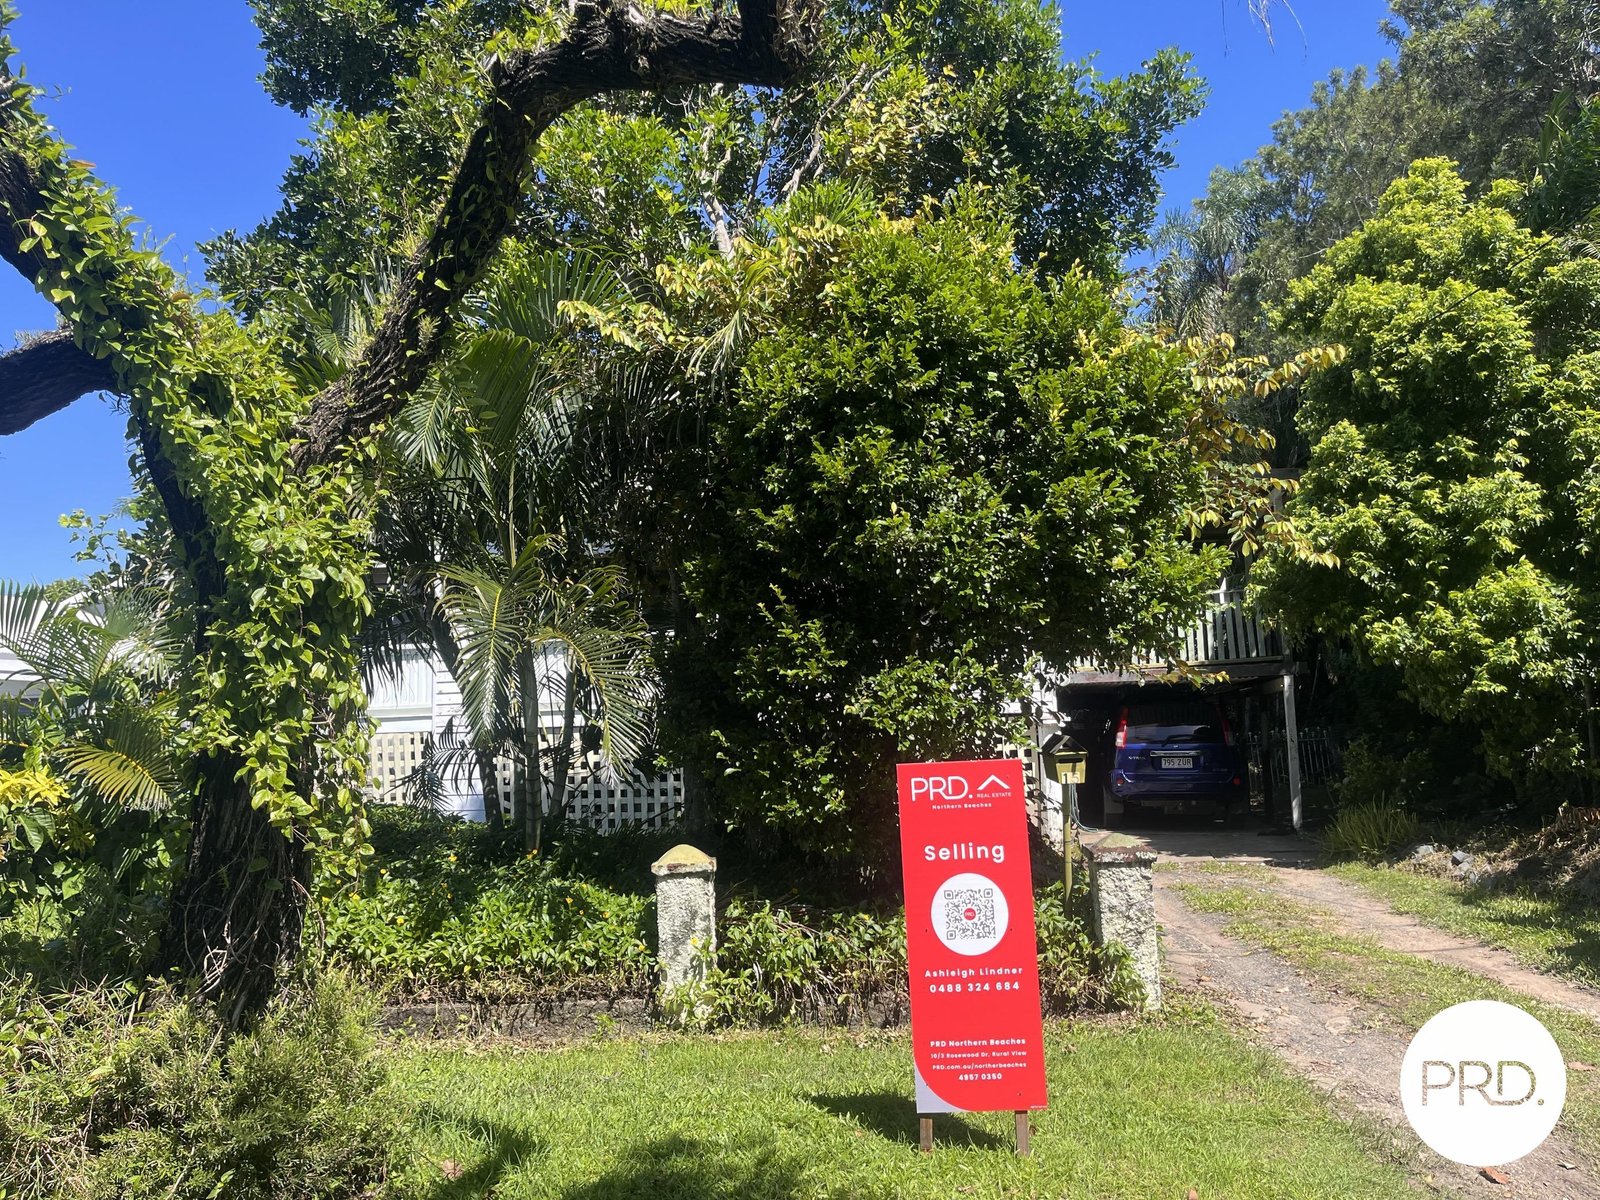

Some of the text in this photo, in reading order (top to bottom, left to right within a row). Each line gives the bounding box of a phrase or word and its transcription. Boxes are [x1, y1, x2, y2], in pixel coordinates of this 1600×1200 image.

[1163, 758, 1191, 766] 795 ZUR
[924, 842, 1005, 863] Selling
[925, 967, 1023, 978] Ashleigh Lindner
[929, 981, 1020, 993] 0488 324 684
[949, 1039, 988, 1047] Northern
[989, 1038, 1026, 1046] Beaches
